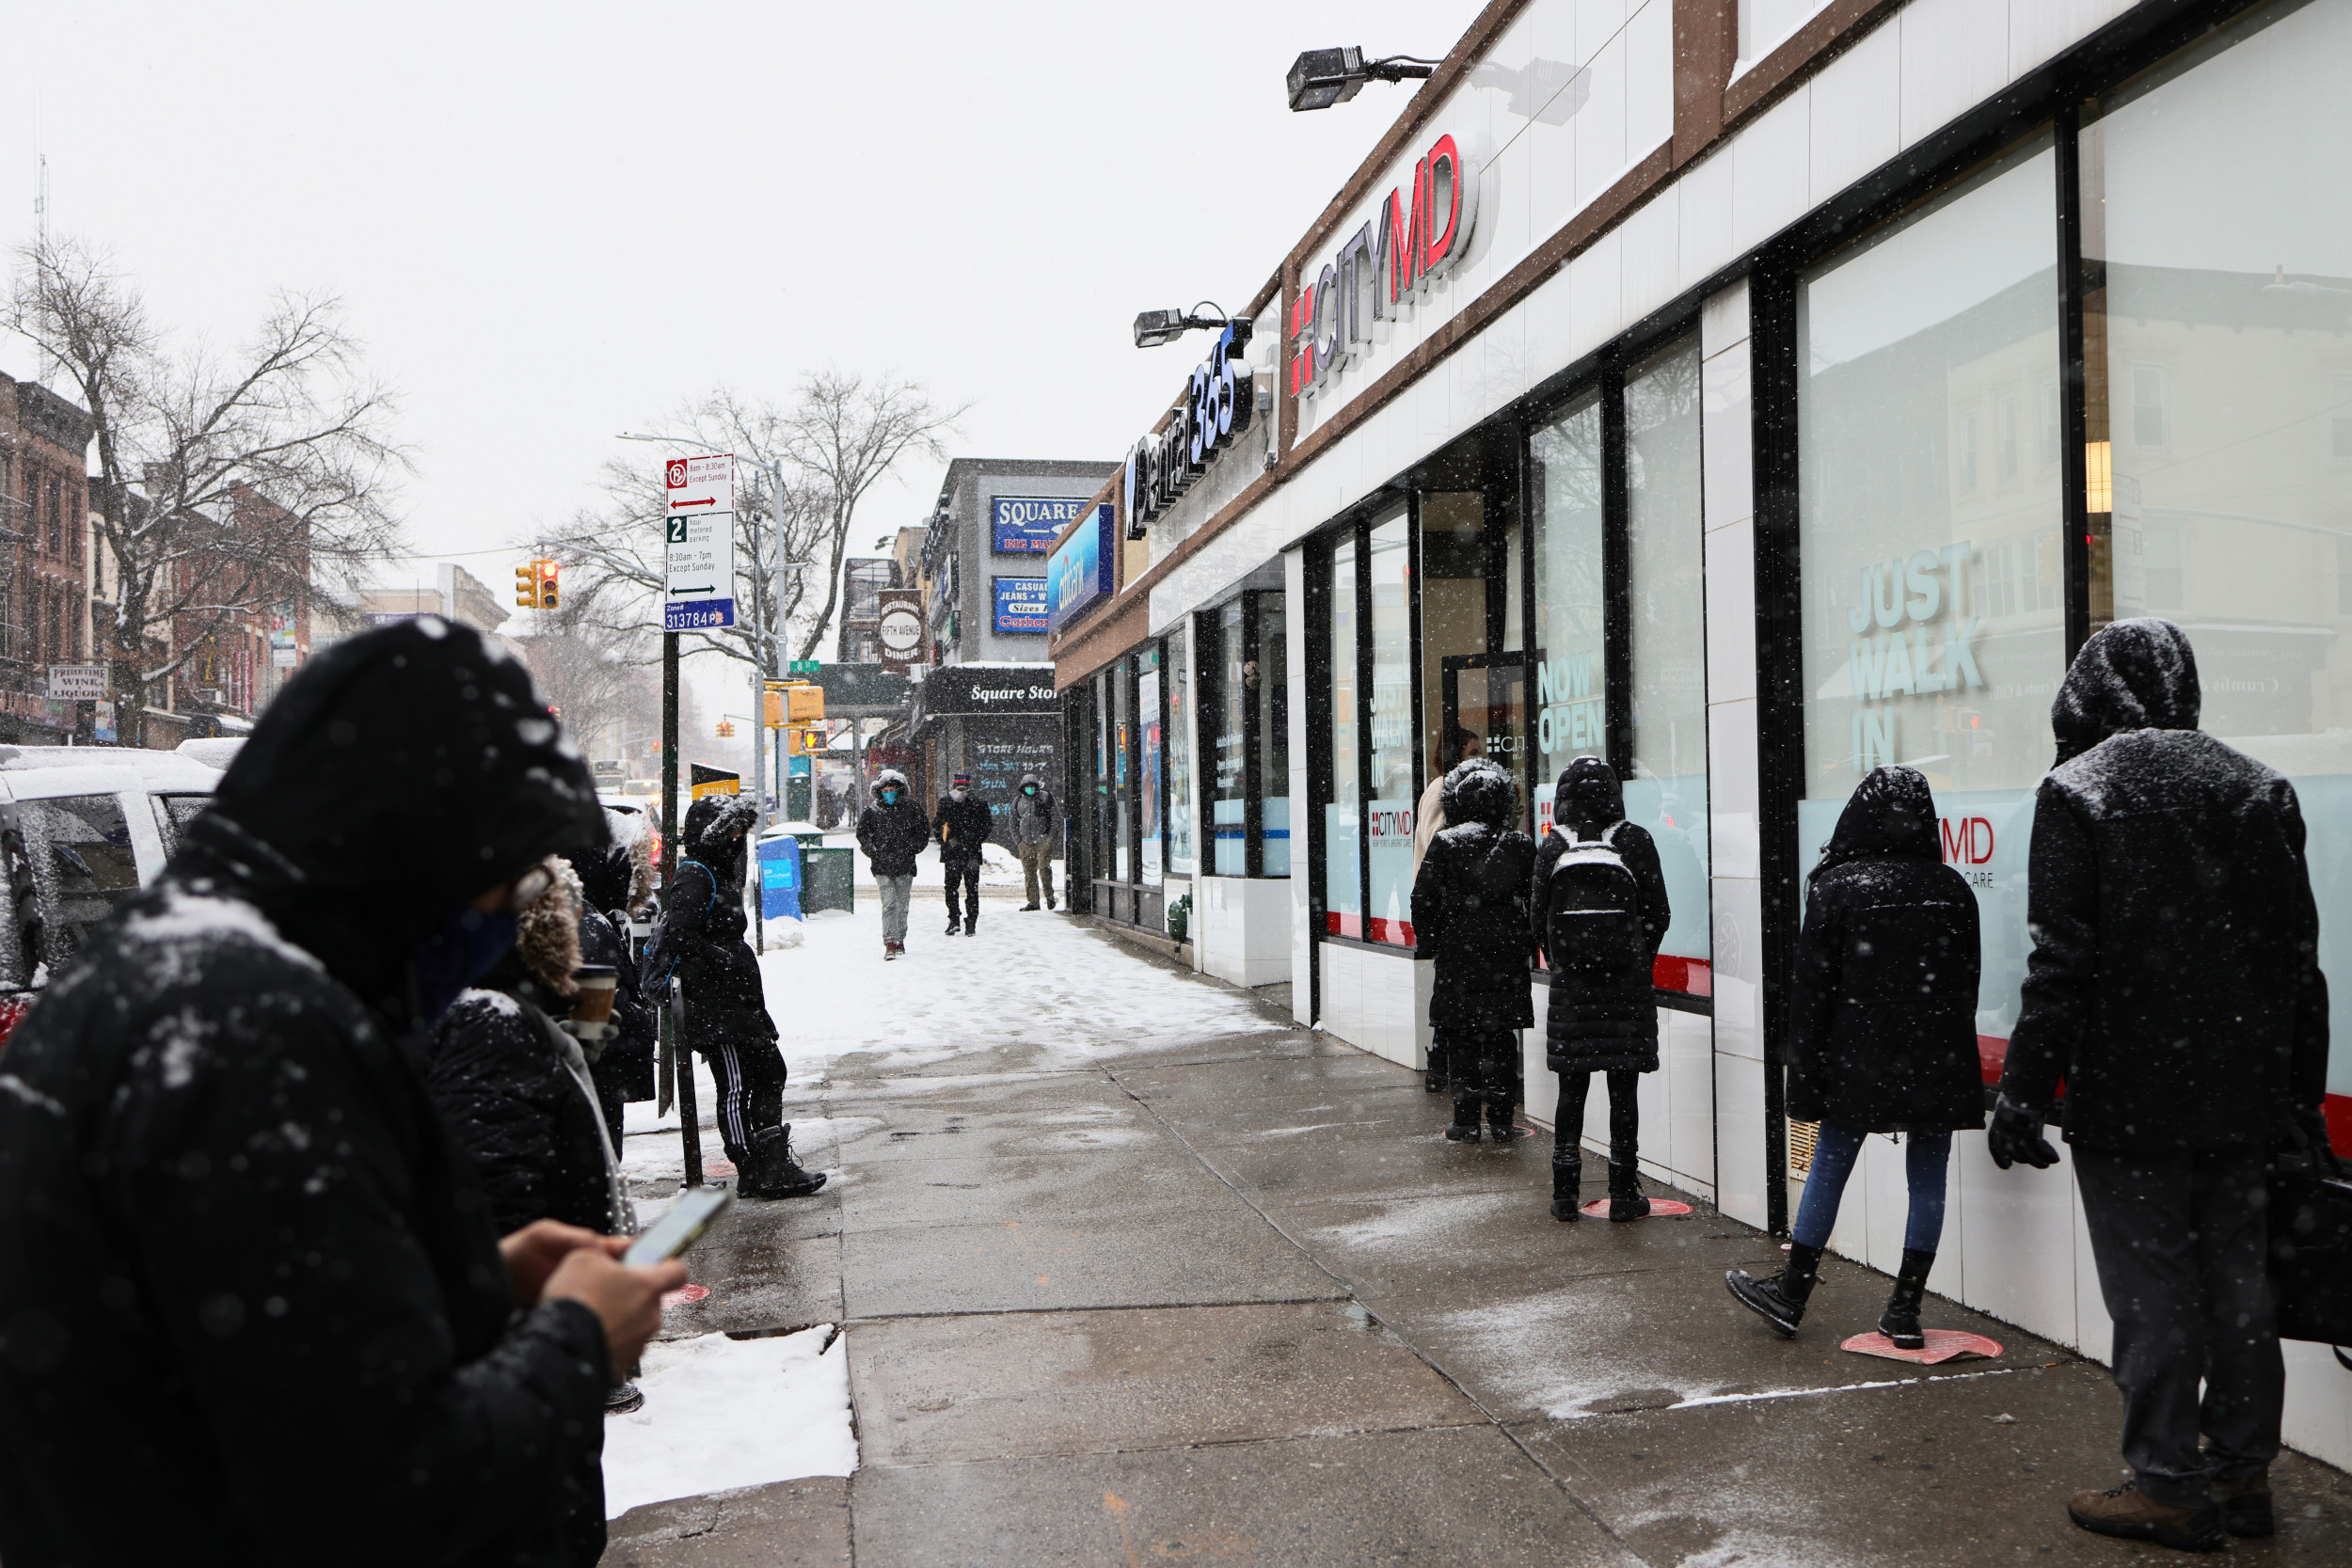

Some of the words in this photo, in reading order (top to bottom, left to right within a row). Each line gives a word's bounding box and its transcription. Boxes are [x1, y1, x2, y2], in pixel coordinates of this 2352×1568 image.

[1314, 134, 1460, 372] CITYMD
[1191, 323, 1234, 465] 365
[706, 462, 725, 470] 8:30am
[690, 475, 707, 483] Except
[708, 473, 727, 482] Sunday
[999, 501, 1079, 527] SQUARE
[671, 517, 682, 542] 2
[1005, 538, 1027, 549] BIG
[669, 553, 692, 562] 8:30am
[699, 551, 712, 561] 7pm
[669, 564, 691, 574] Except
[692, 562, 715, 572] Sunday
[1847, 540, 1971, 635] JUST
[1000, 592, 1027, 601] JEANS
[881, 600, 919, 616] RESTAURANT
[1012, 604, 1040, 612] Sizes
[666, 611, 707, 628] 313784
[999, 615, 1048, 627] Carhar
[882, 625, 898, 636] FIFTH
[899, 625, 919, 636] AVENUE
[884, 647, 918, 660] DINER
[1848, 616, 1983, 702] WALK
[1537, 650, 1593, 705] NOW
[54, 689, 105, 698] LIQUORS
[971, 686, 1025, 704] Square
[1028, 685, 1057, 700] Stor
[1538, 700, 1604, 754] OPEN
[1851, 705, 1895, 773] IN
[1378, 811, 1412, 836] CITYMD
[1964, 872, 1994, 889] CARE
